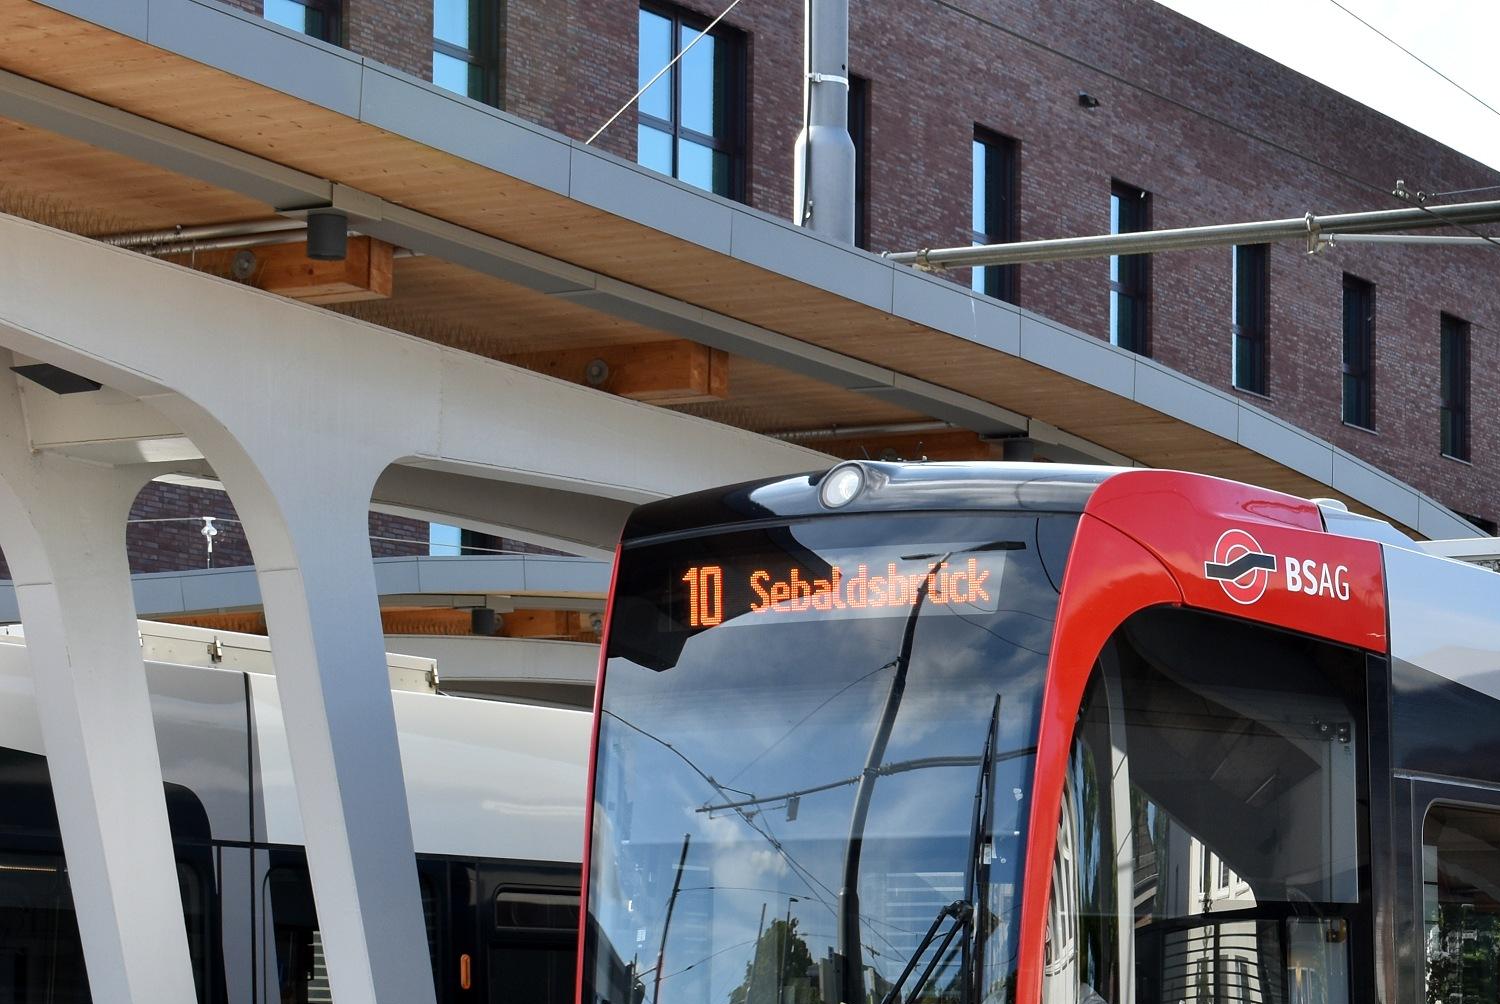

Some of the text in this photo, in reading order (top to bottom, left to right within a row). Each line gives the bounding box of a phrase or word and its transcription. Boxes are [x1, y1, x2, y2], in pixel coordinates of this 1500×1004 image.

[682, 558, 990, 627] 10 Sebaldsbrück
[1285, 556, 1350, 601] BSAG
